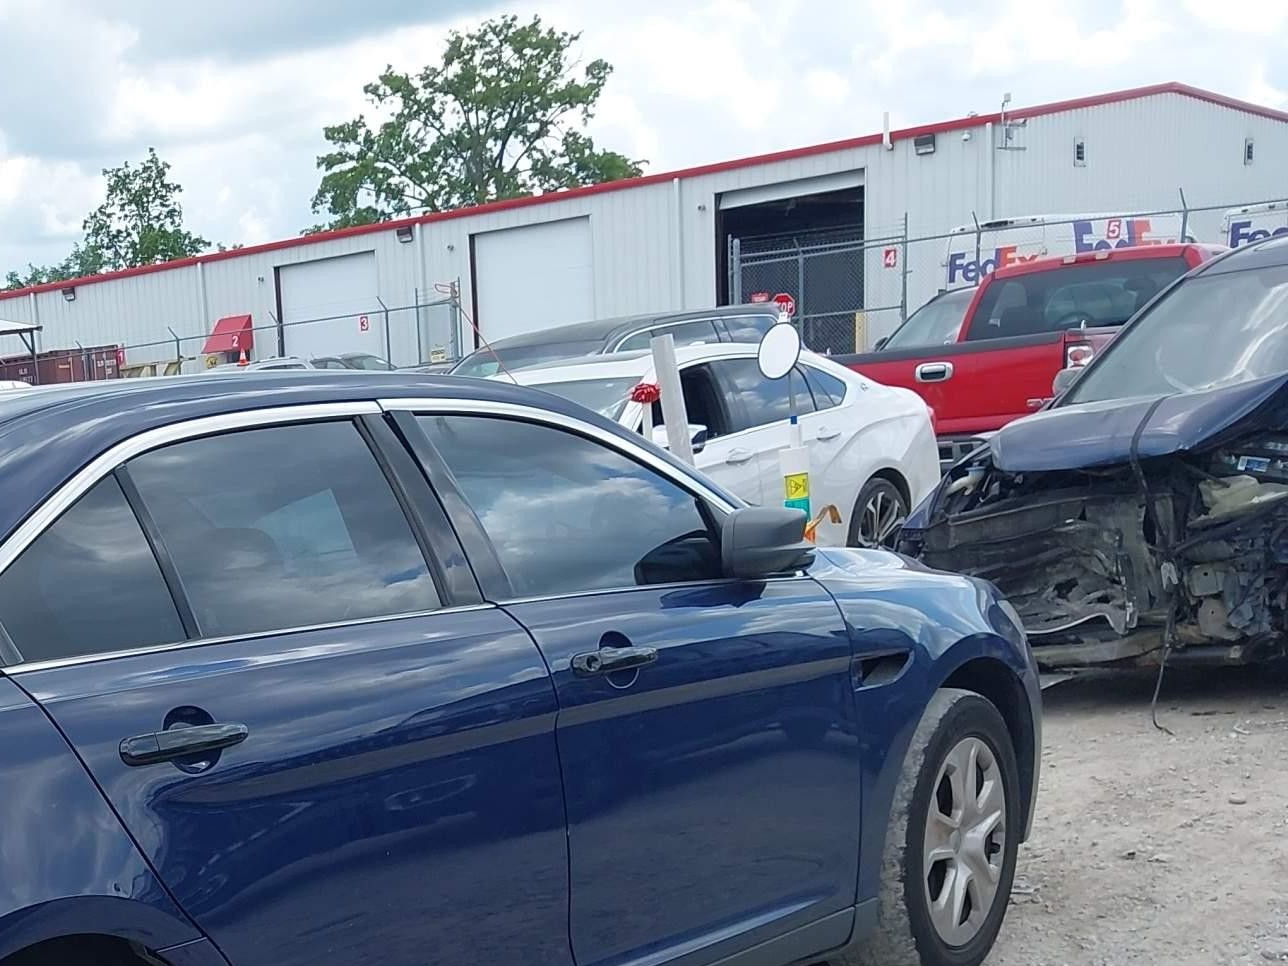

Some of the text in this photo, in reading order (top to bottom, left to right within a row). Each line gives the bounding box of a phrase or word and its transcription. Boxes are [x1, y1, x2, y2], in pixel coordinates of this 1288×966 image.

[1107, 219, 1120, 238] 5
[885, 250, 895, 266] 4
[361, 317, 368, 330] 3
[231, 335, 239, 347] 2
